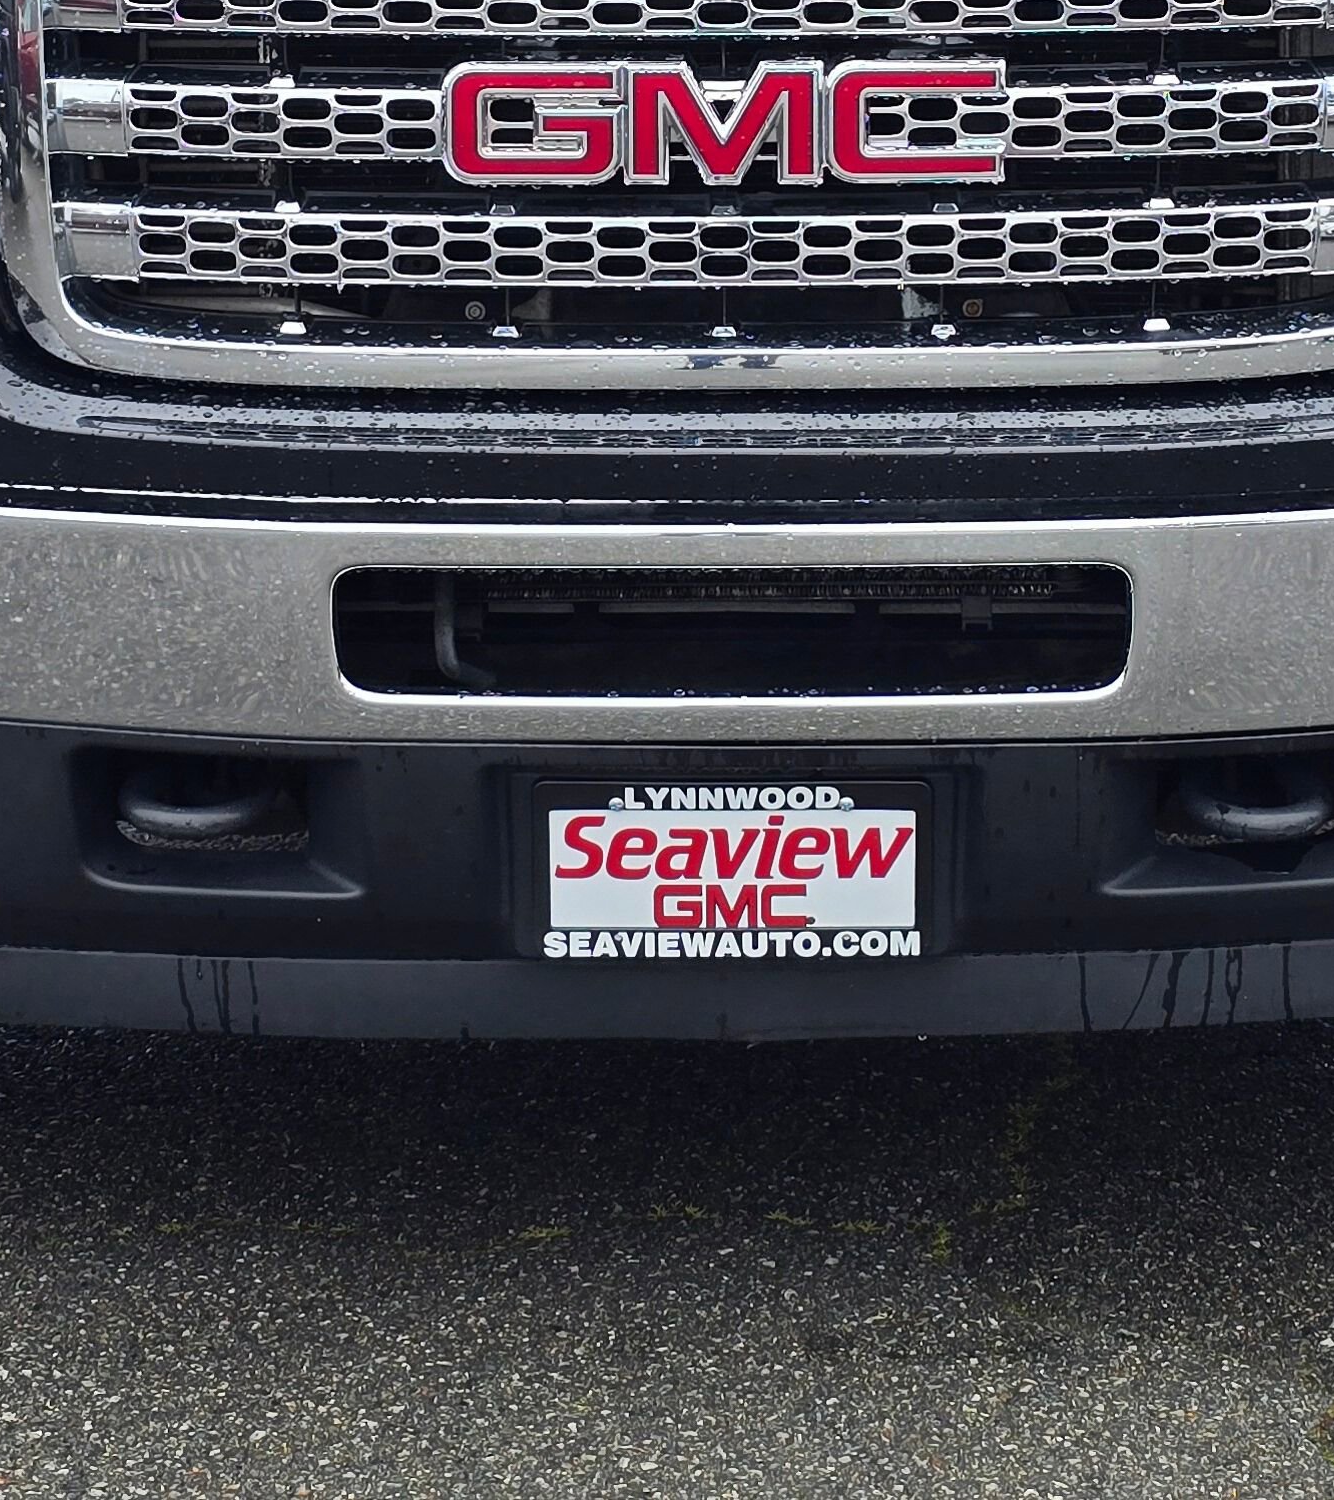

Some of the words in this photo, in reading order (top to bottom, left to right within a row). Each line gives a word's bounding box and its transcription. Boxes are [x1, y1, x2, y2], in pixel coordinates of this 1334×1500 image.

[441, 59, 1006, 186] GMC
[624, 786, 841, 810] LYNNWOOD
[554, 814, 914, 881] Seaview
[653, 883, 807, 929] GMC
[543, 930, 921, 959] SEAVIEWAUTO.COM
